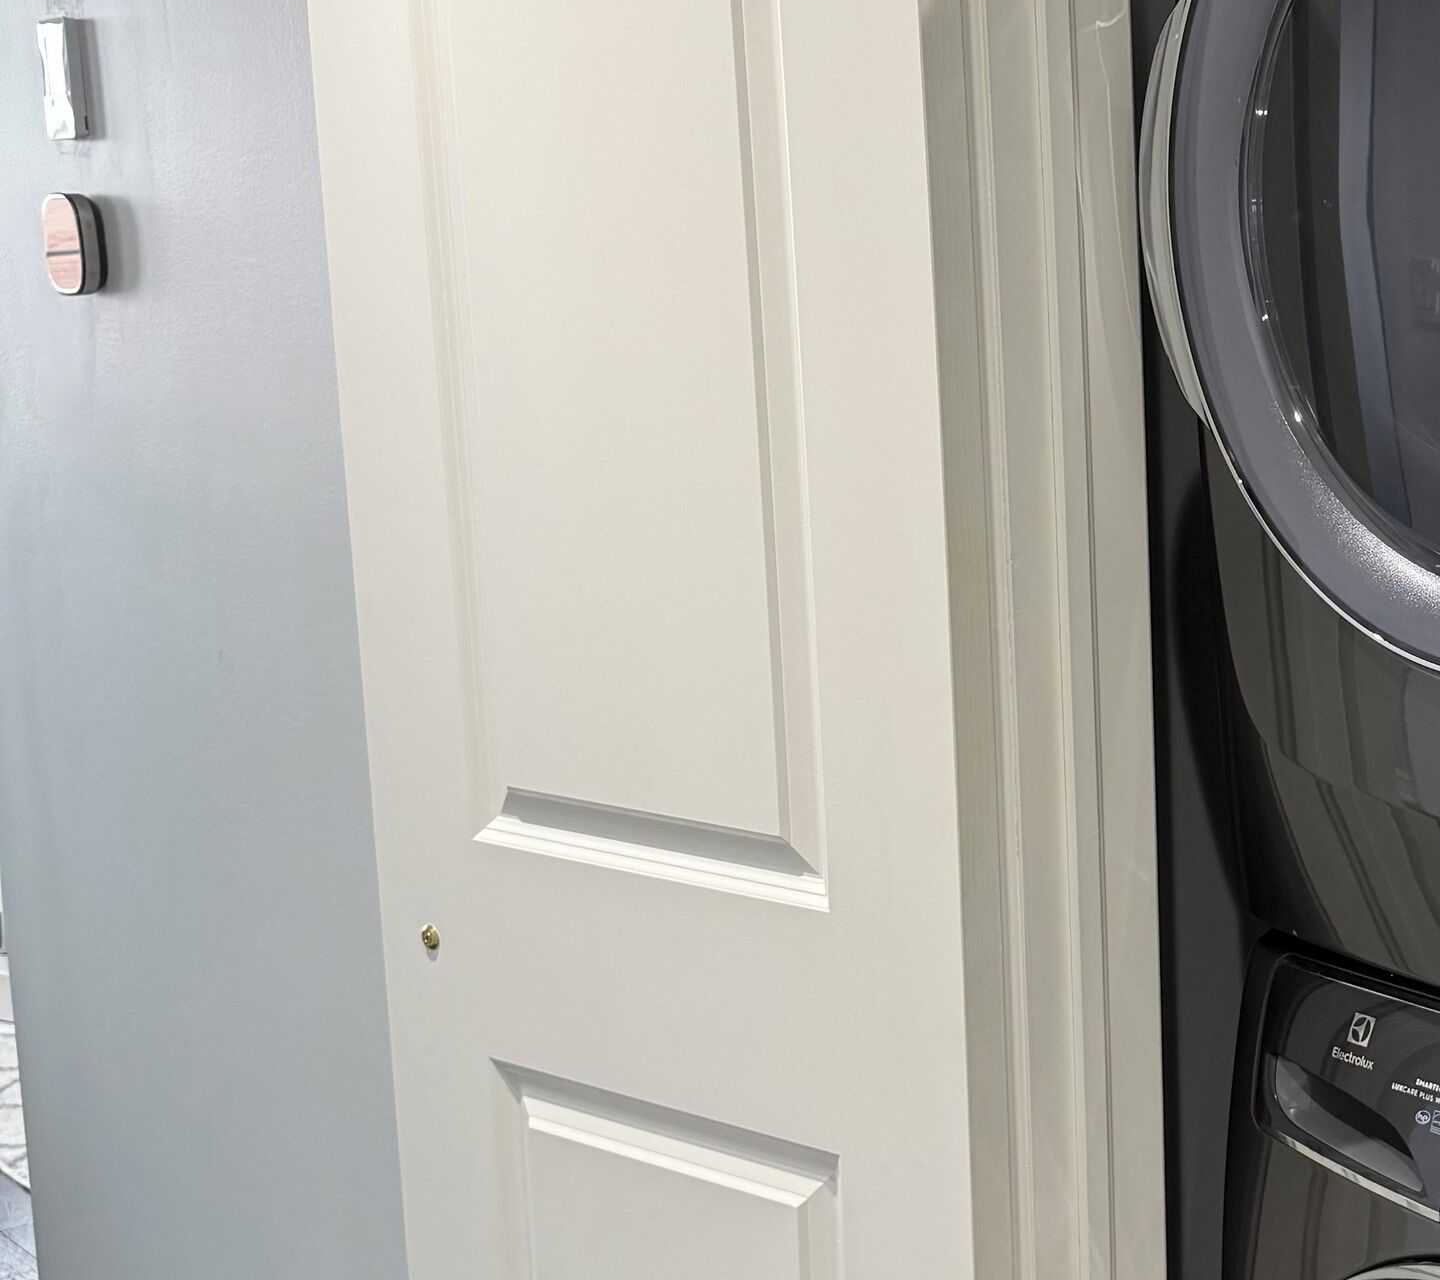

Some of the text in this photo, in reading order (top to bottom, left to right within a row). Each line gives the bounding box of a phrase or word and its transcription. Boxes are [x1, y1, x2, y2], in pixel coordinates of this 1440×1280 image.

[1331, 1046, 1375, 1071] Electrolux
[1391, 1082, 1419, 1097] LUXCARE
[1419, 1091, 1434, 1102] PLUS
